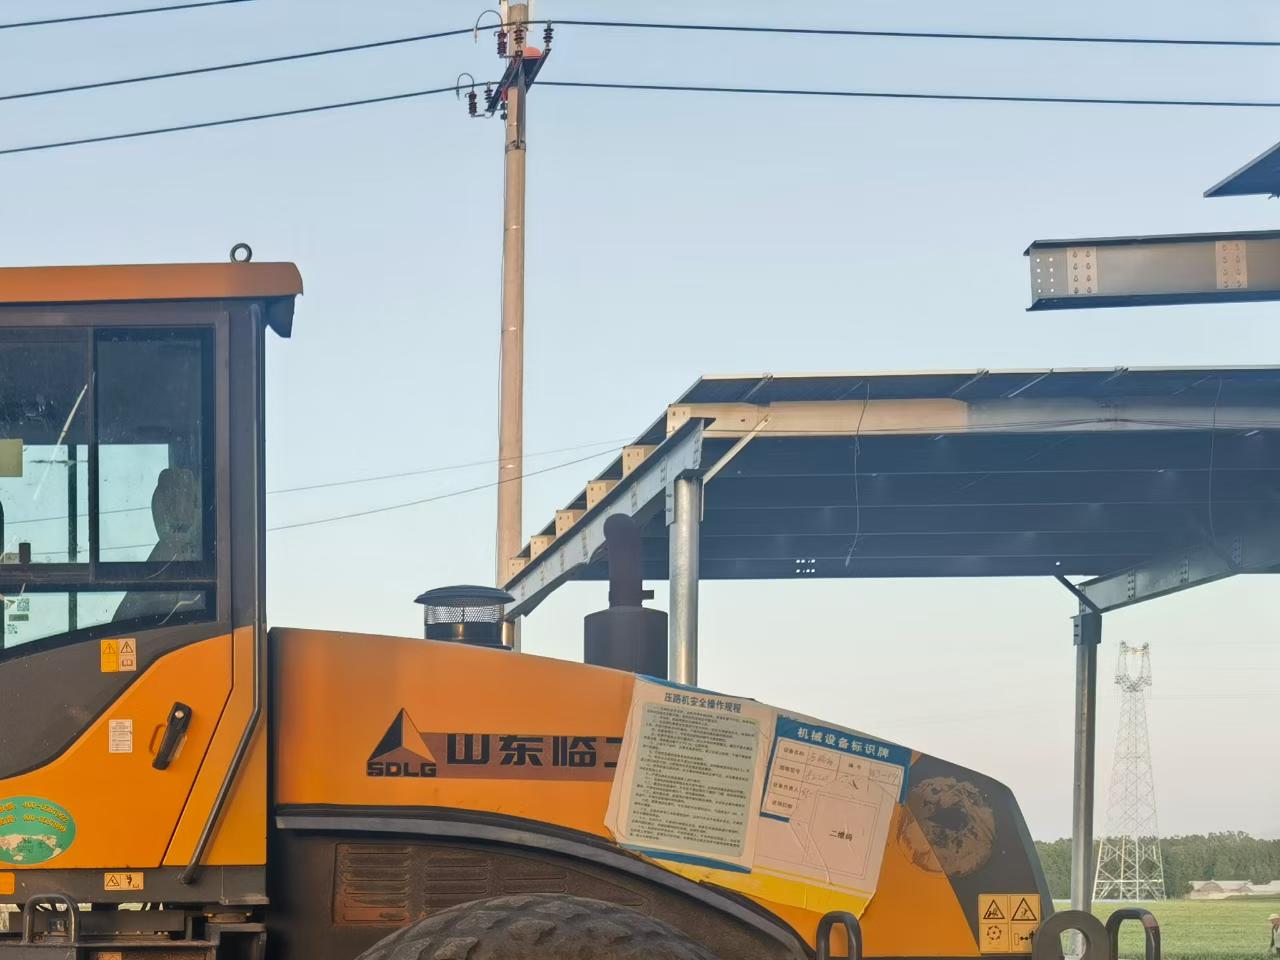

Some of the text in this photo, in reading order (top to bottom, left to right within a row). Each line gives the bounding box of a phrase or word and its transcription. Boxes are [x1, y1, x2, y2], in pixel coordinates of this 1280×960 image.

[664, 692, 742, 714] 压路机安全操作规程
[797, 727, 890, 758] 机械设备标识牌
[367, 762, 437, 777] SDLG
[830, 830, 853, 841] 二维码
